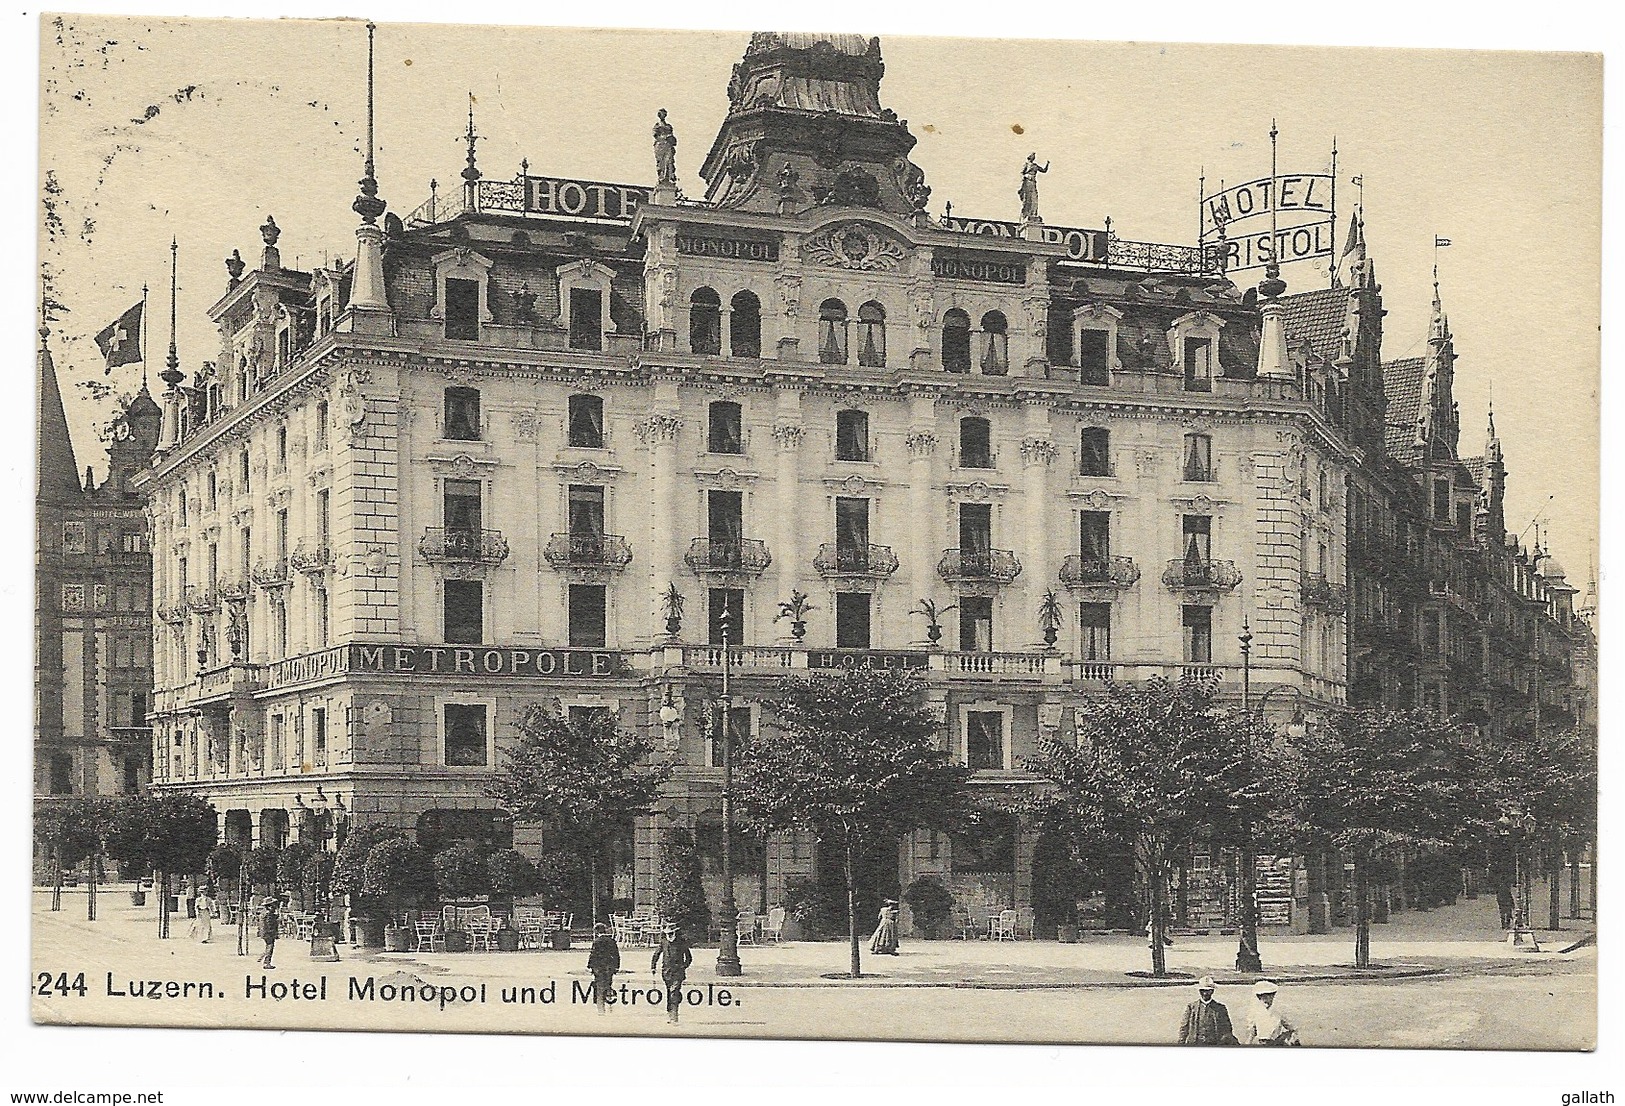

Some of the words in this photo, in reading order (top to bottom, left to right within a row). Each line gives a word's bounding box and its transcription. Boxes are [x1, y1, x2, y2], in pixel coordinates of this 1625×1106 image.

[529, 179, 652, 218] HOTE
[1208, 178, 1324, 226] HOTEL
[931, 259, 1017, 281] MONOPOL
[281, 645, 349, 687] MONOPOL
[358, 646, 612, 676] METROPOLE
